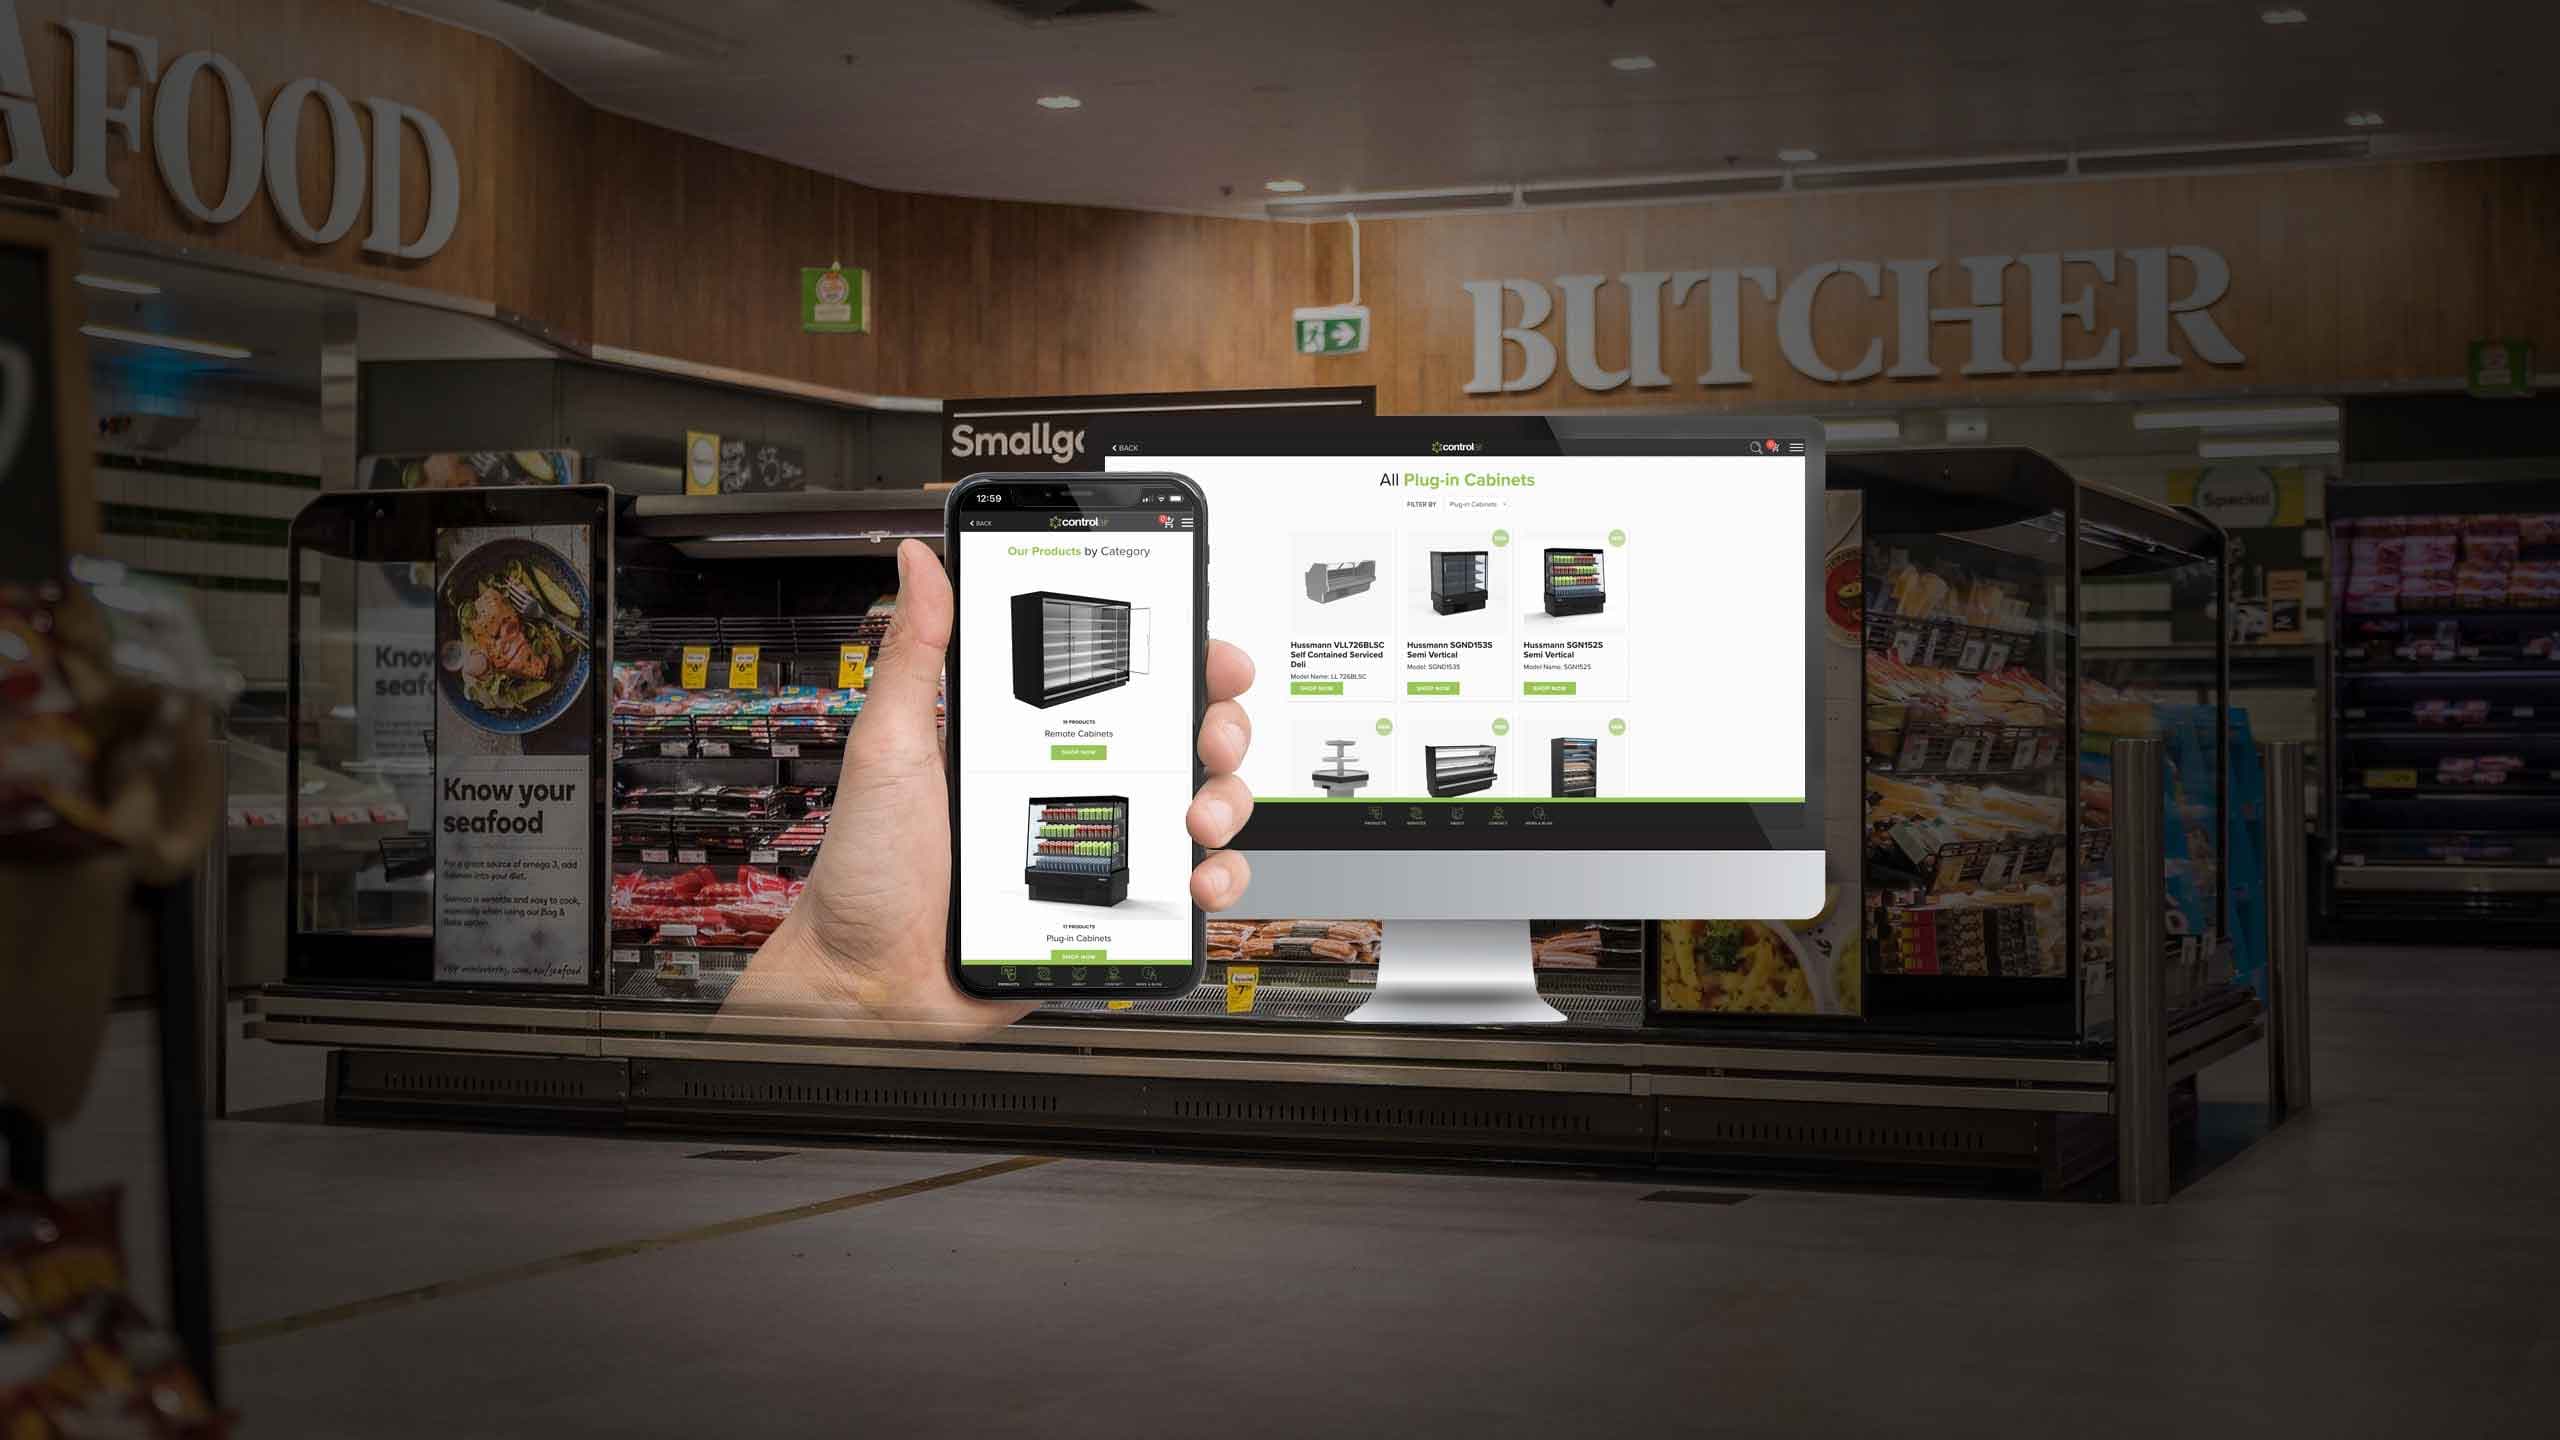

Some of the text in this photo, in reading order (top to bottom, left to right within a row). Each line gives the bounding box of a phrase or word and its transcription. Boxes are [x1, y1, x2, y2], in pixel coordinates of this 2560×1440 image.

[1462, 244, 2246, 395] BUTCHER
[1119, 444, 1139, 452] BACK
[1379, 472, 1536, 490] All Plug-in Cabinets
[976, 494, 1002, 503] 12:59
[1449, 501, 1471, 509] Plug-in
[1008, 546, 1151, 559] Our Products by Category
[1290, 641, 1385, 649] Hussmann VLL726BLSC
[1407, 641, 1493, 649] Hussmann SGND153S
[1523, 641, 1604, 649] Hussmann SGN152S
[1290, 651, 1384, 659] Self Contained Serviced
[1407, 651, 1458, 659] Semi Vertical
[1523, 651, 1575, 659] Semi Vertical
[1044, 730, 1114, 738] Remote Cabinets
[443, 777, 576, 808] Know your
[443, 809, 544, 834] seafood
[522, 862, 550, 871] omega
[561, 861, 577, 869] add
[512, 896, 529, 904] and
[550, 897, 558, 905] to
[1046, 934, 1112, 944] Plug-in Cabinets
